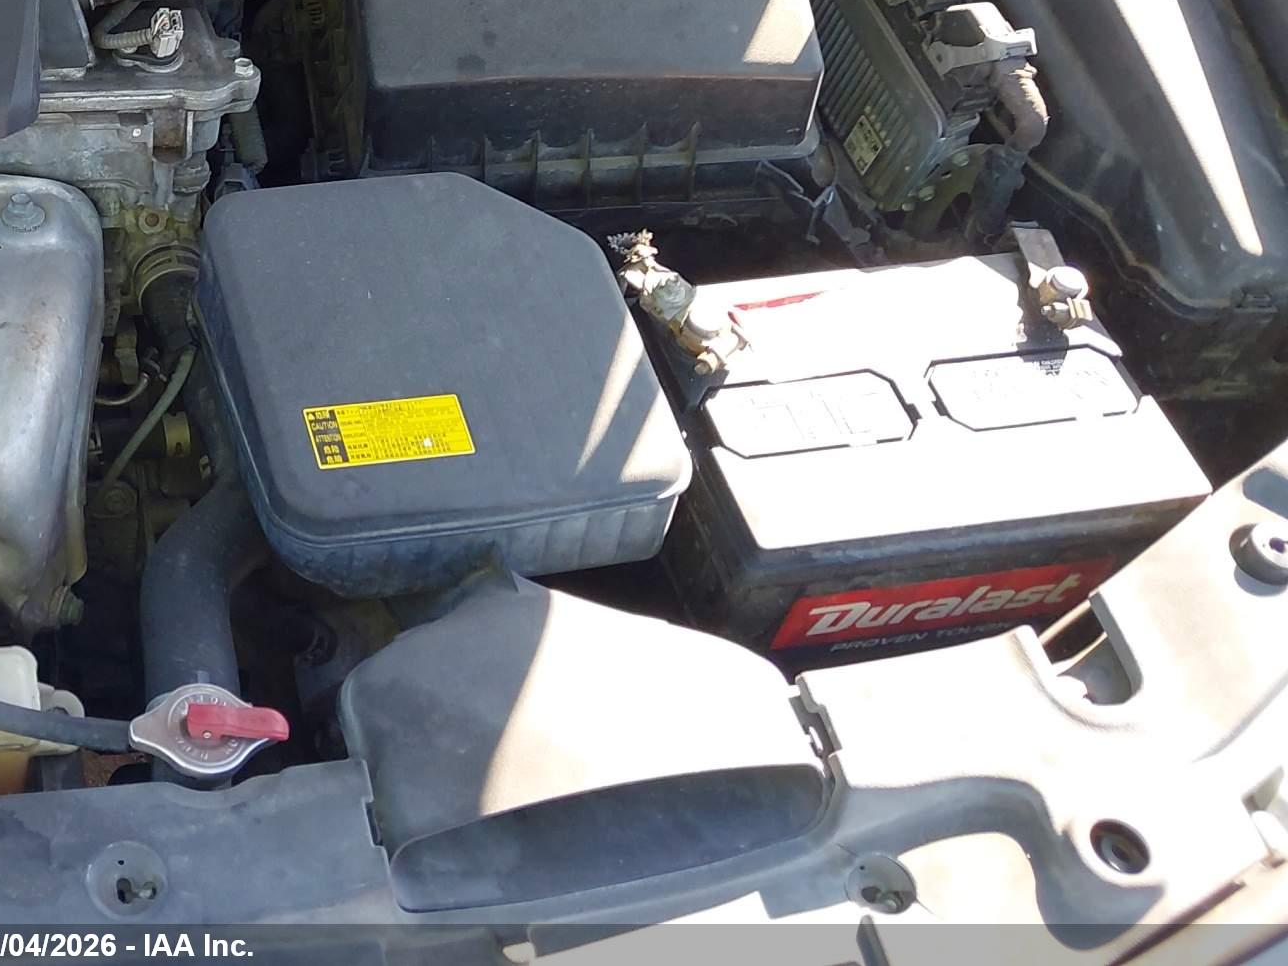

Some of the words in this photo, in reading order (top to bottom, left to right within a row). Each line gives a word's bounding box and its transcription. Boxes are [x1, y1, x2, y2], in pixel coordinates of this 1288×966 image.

[311, 420, 338, 431] CAUTION
[805, 573, 1081, 636] Duralast
[829, 631, 929, 653] PROVEN
